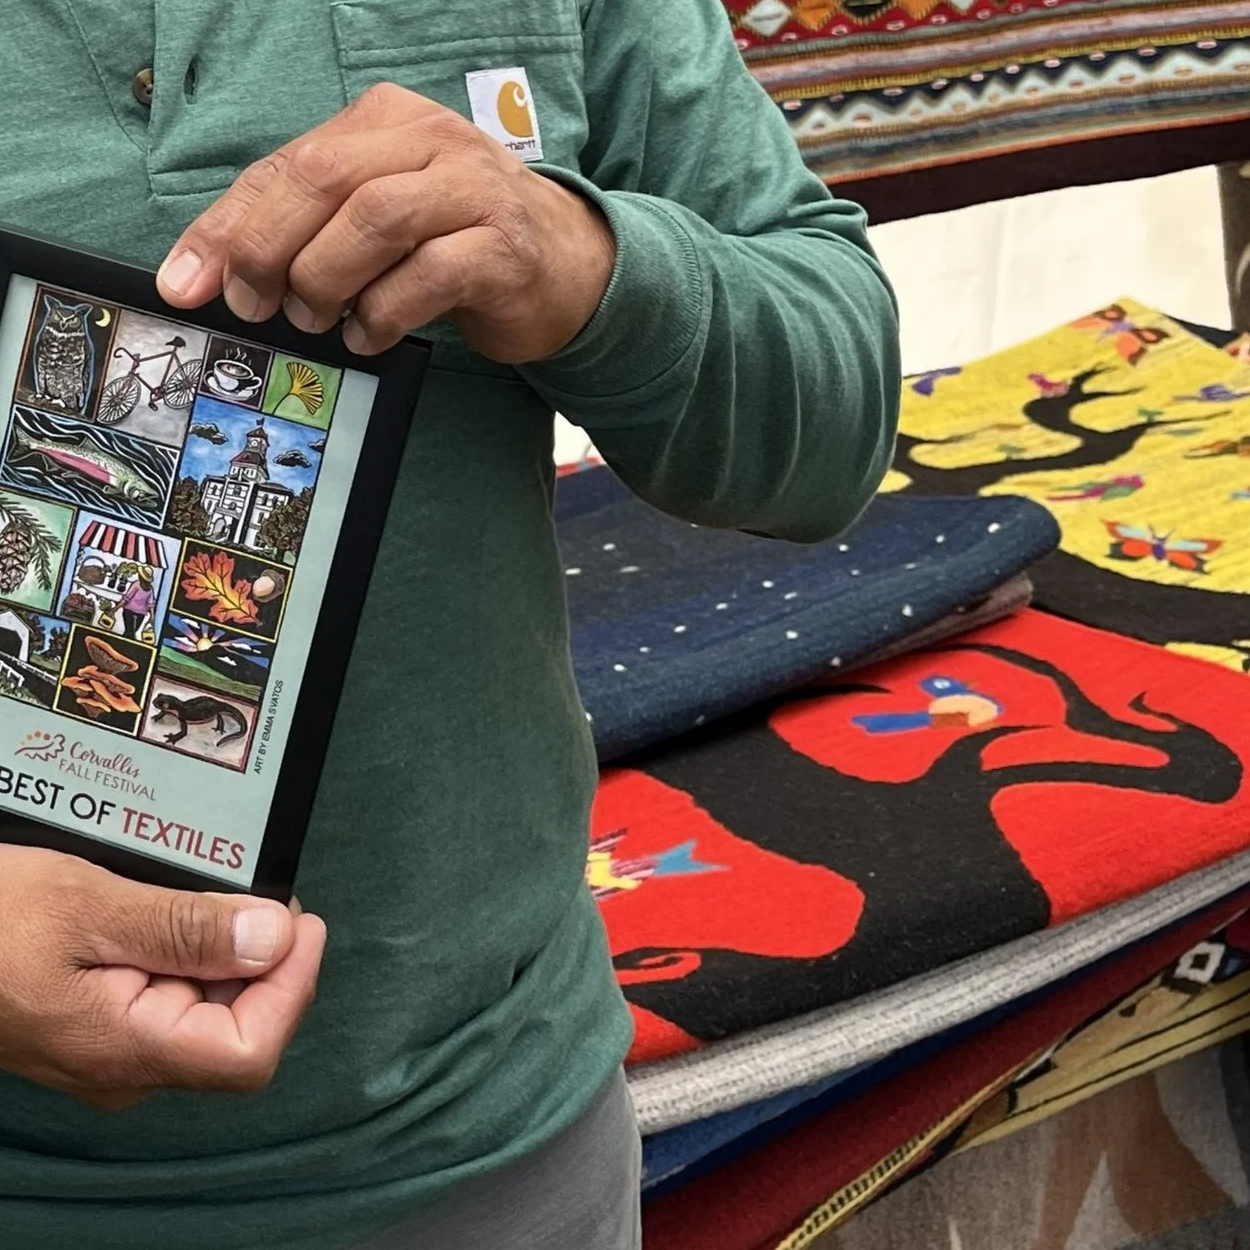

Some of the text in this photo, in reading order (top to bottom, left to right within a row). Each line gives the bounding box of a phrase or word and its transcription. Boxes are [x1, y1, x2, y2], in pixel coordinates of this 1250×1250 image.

[253, 679, 284, 775] ART BY EMMA SVATOS
[59, 758, 157, 802] FALL FESTIVAL
[69, 741, 141, 778] Corvallis
[69, 792, 117, 825] OF
[122, 806, 246, 870] TEXTILES
